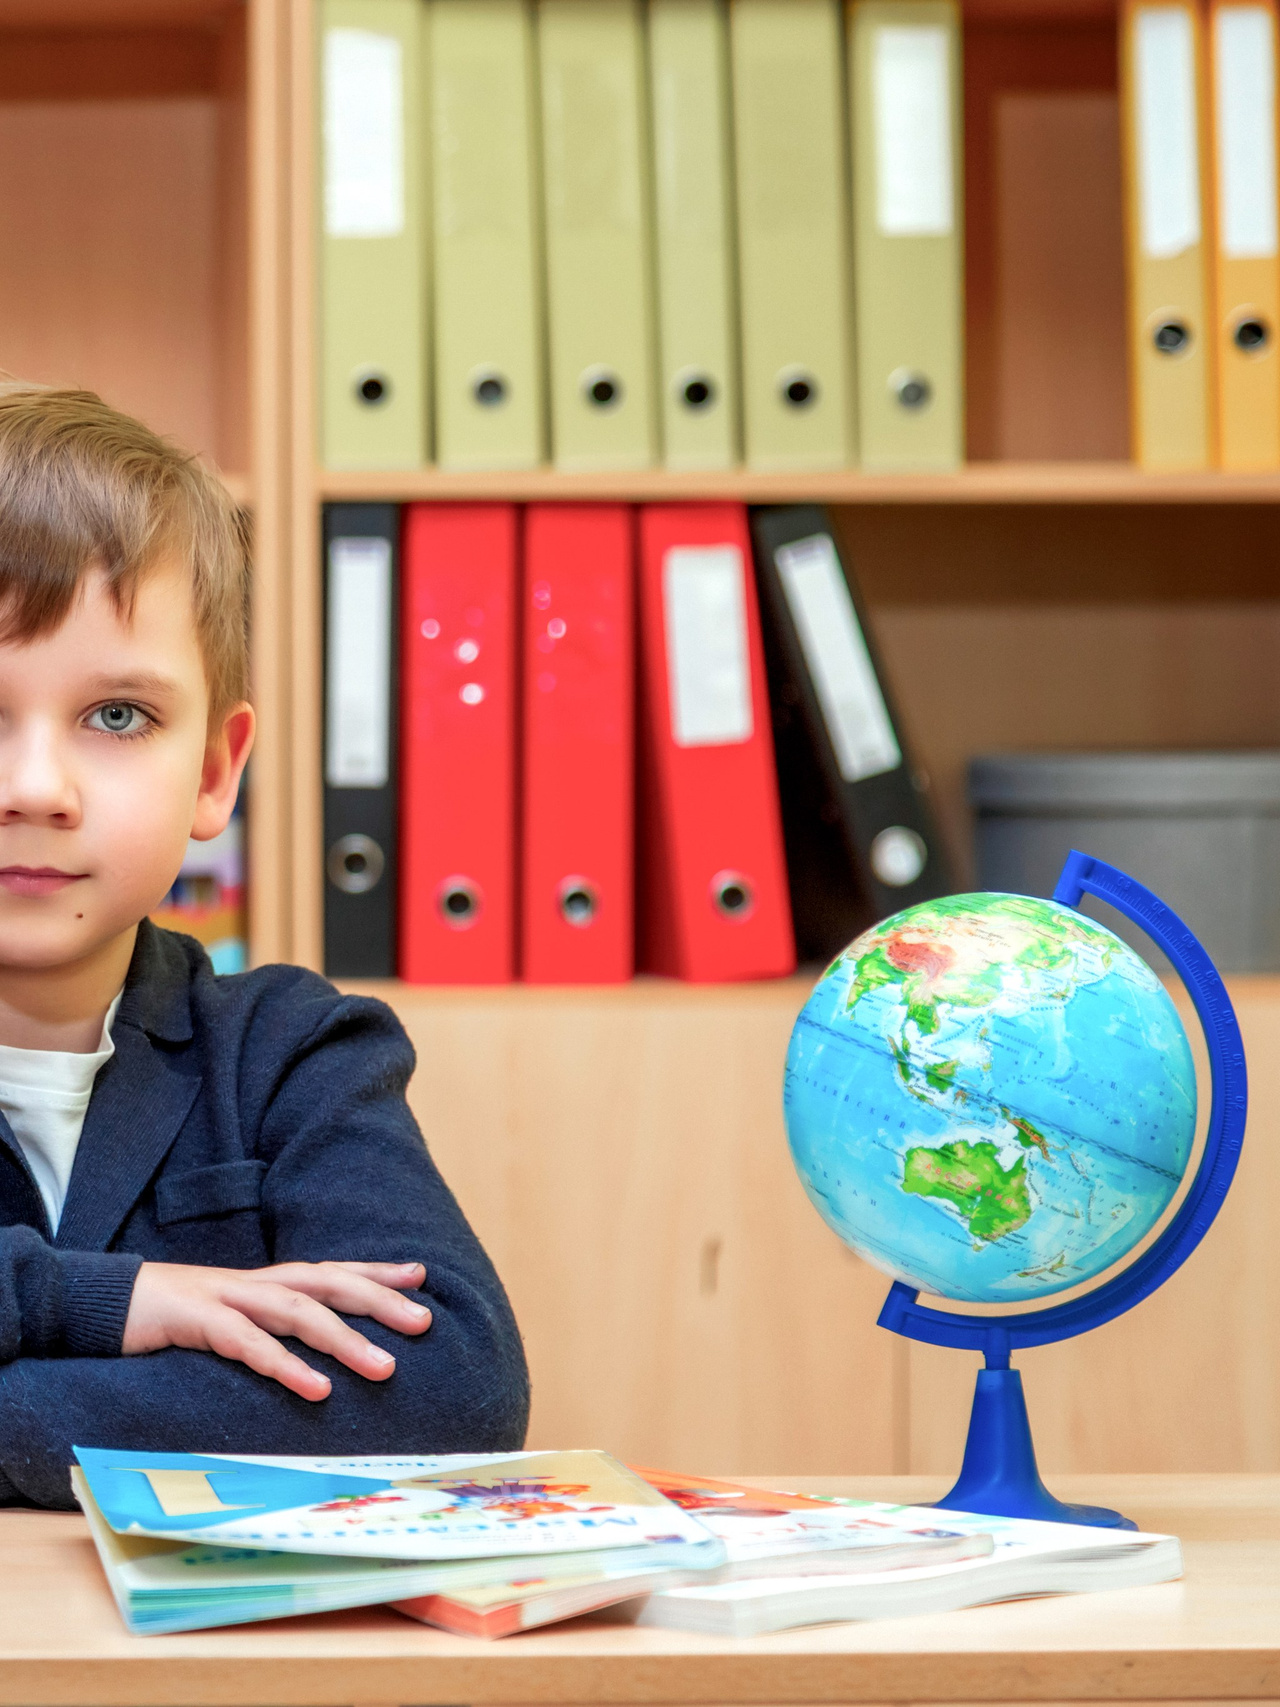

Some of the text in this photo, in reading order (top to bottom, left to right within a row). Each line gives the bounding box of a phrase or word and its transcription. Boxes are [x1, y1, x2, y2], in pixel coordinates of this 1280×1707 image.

[1206, 970, 1218, 985] 50
[1235, 1095, 1245, 1110] 20
[1230, 1139, 1239, 1152] 10
[108, 1467, 266, 1517] 1
